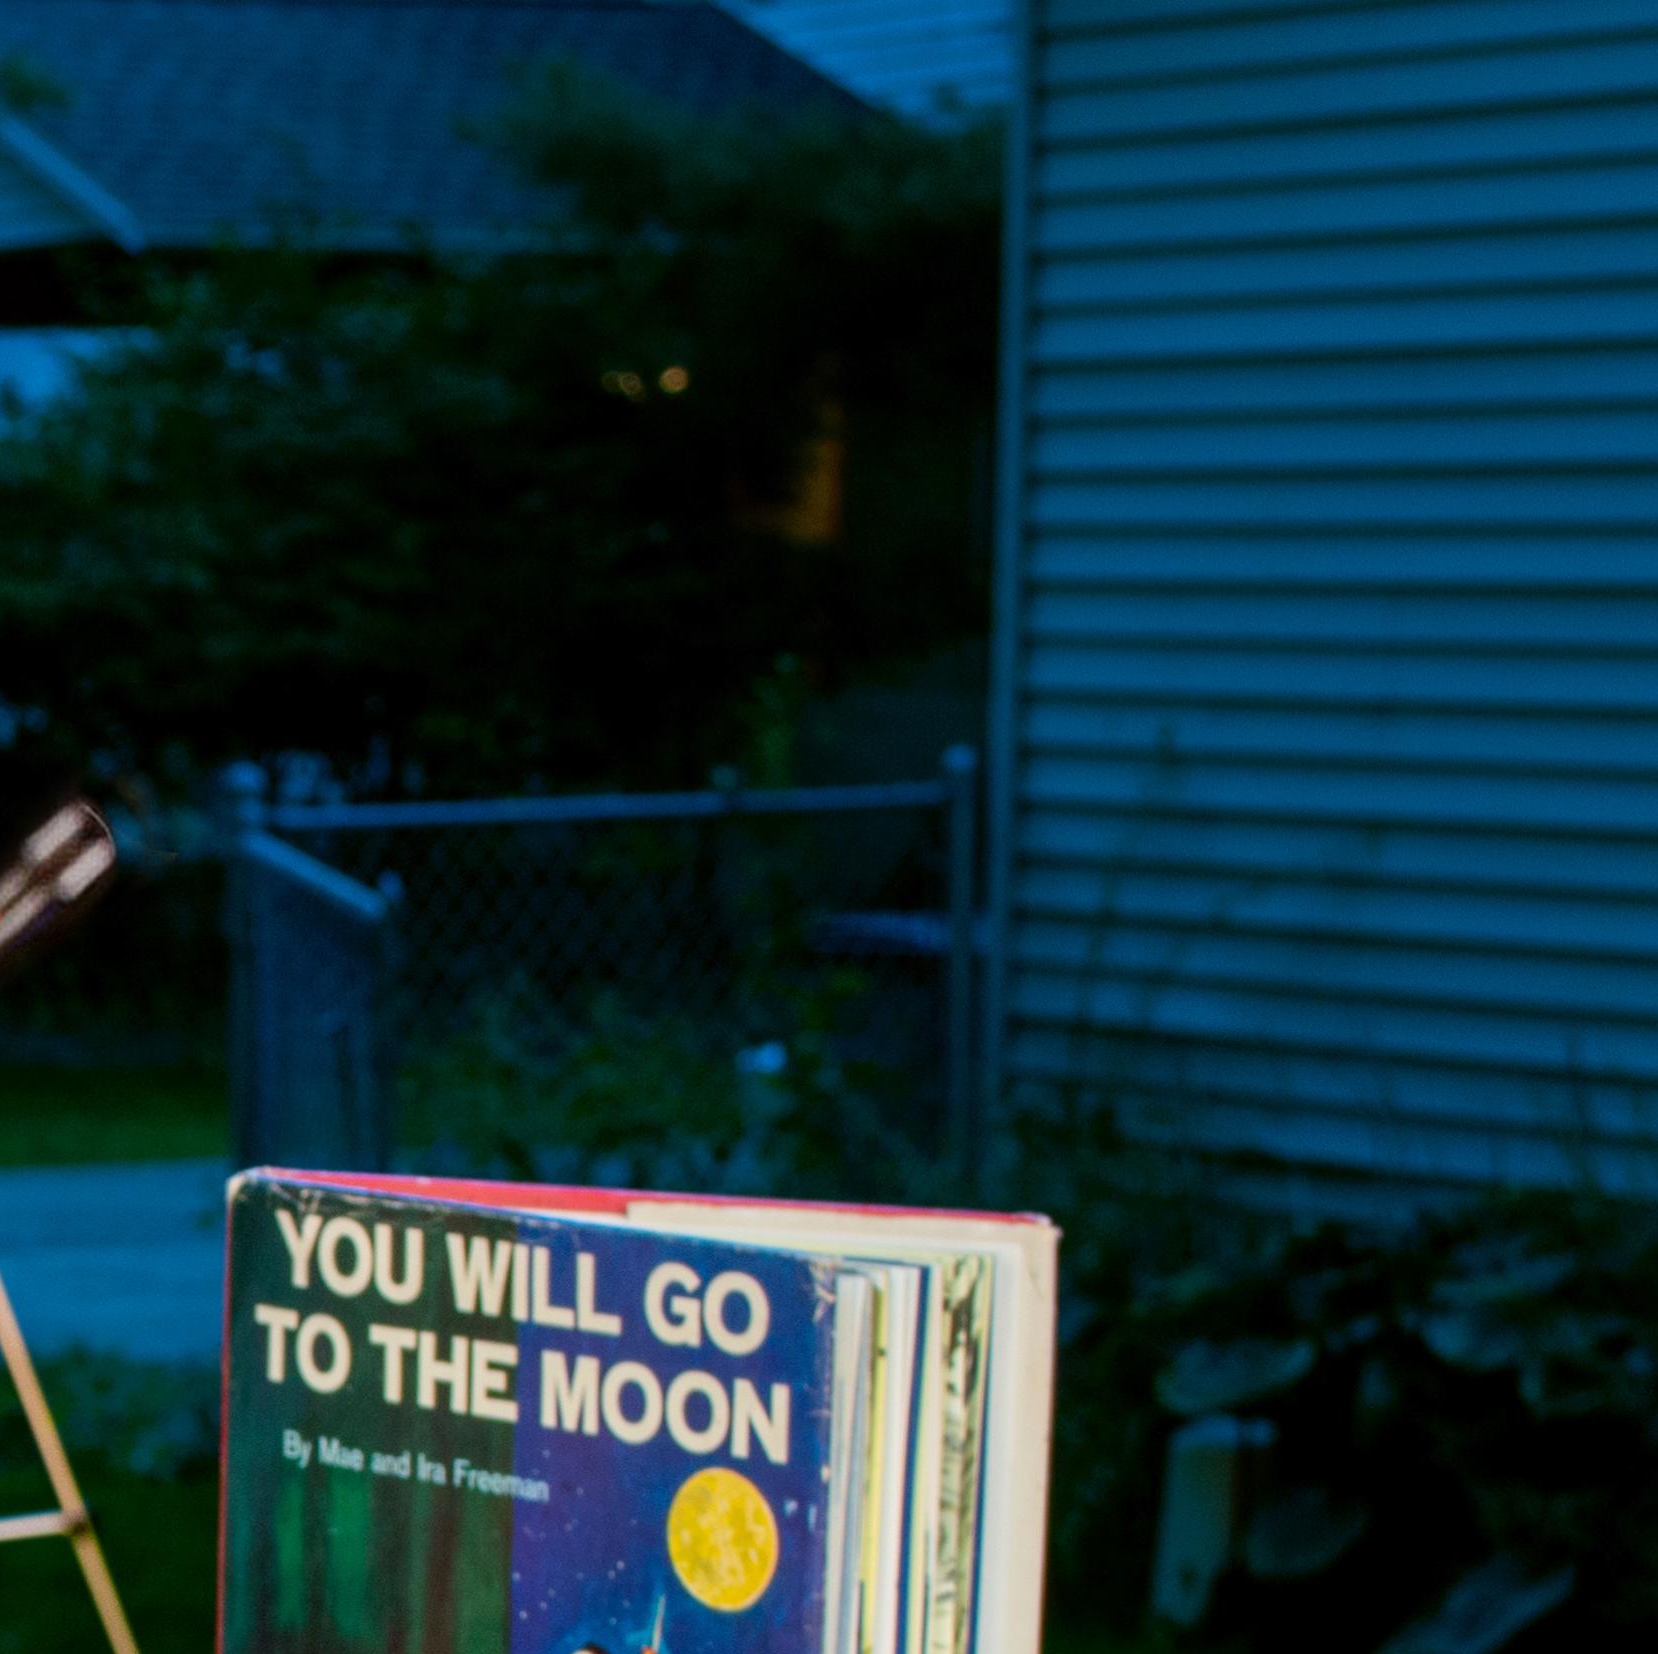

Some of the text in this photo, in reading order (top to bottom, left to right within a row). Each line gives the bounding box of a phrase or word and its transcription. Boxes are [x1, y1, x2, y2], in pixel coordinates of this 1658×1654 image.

[276, 1209, 770, 1357] YOU WILL GO
[254, 1304, 791, 1465] TO THE MOON
[283, 1428, 550, 1501] By Mae and Ira Freeman
